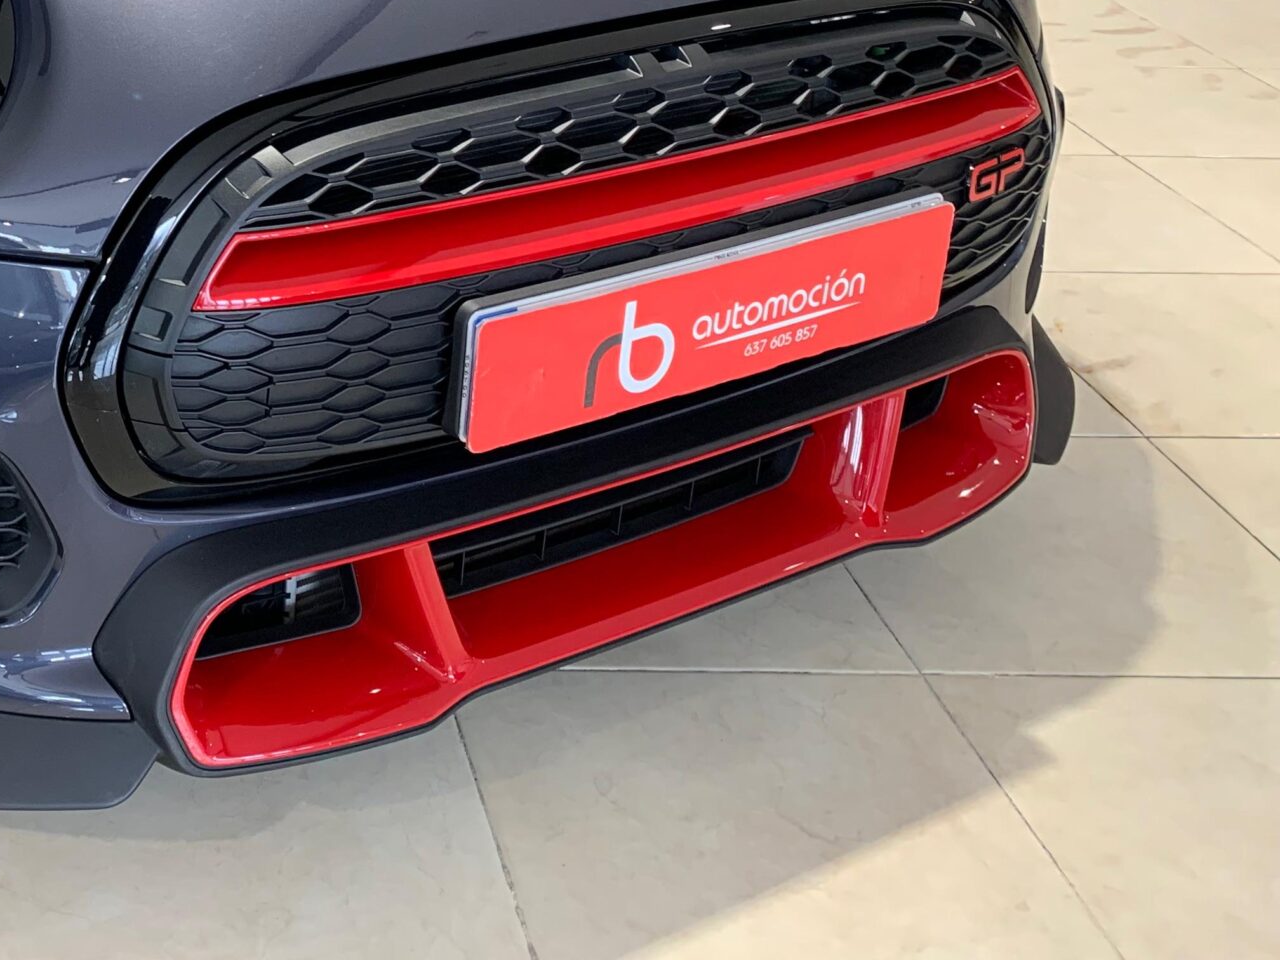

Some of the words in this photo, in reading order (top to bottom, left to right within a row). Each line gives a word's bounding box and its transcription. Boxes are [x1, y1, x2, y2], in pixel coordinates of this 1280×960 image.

[969, 147, 1025, 204] GP
[692, 268, 866, 341] automoción
[744, 339, 767, 357] 637
[770, 332, 793, 350] 605
[795, 324, 818, 342] 857
